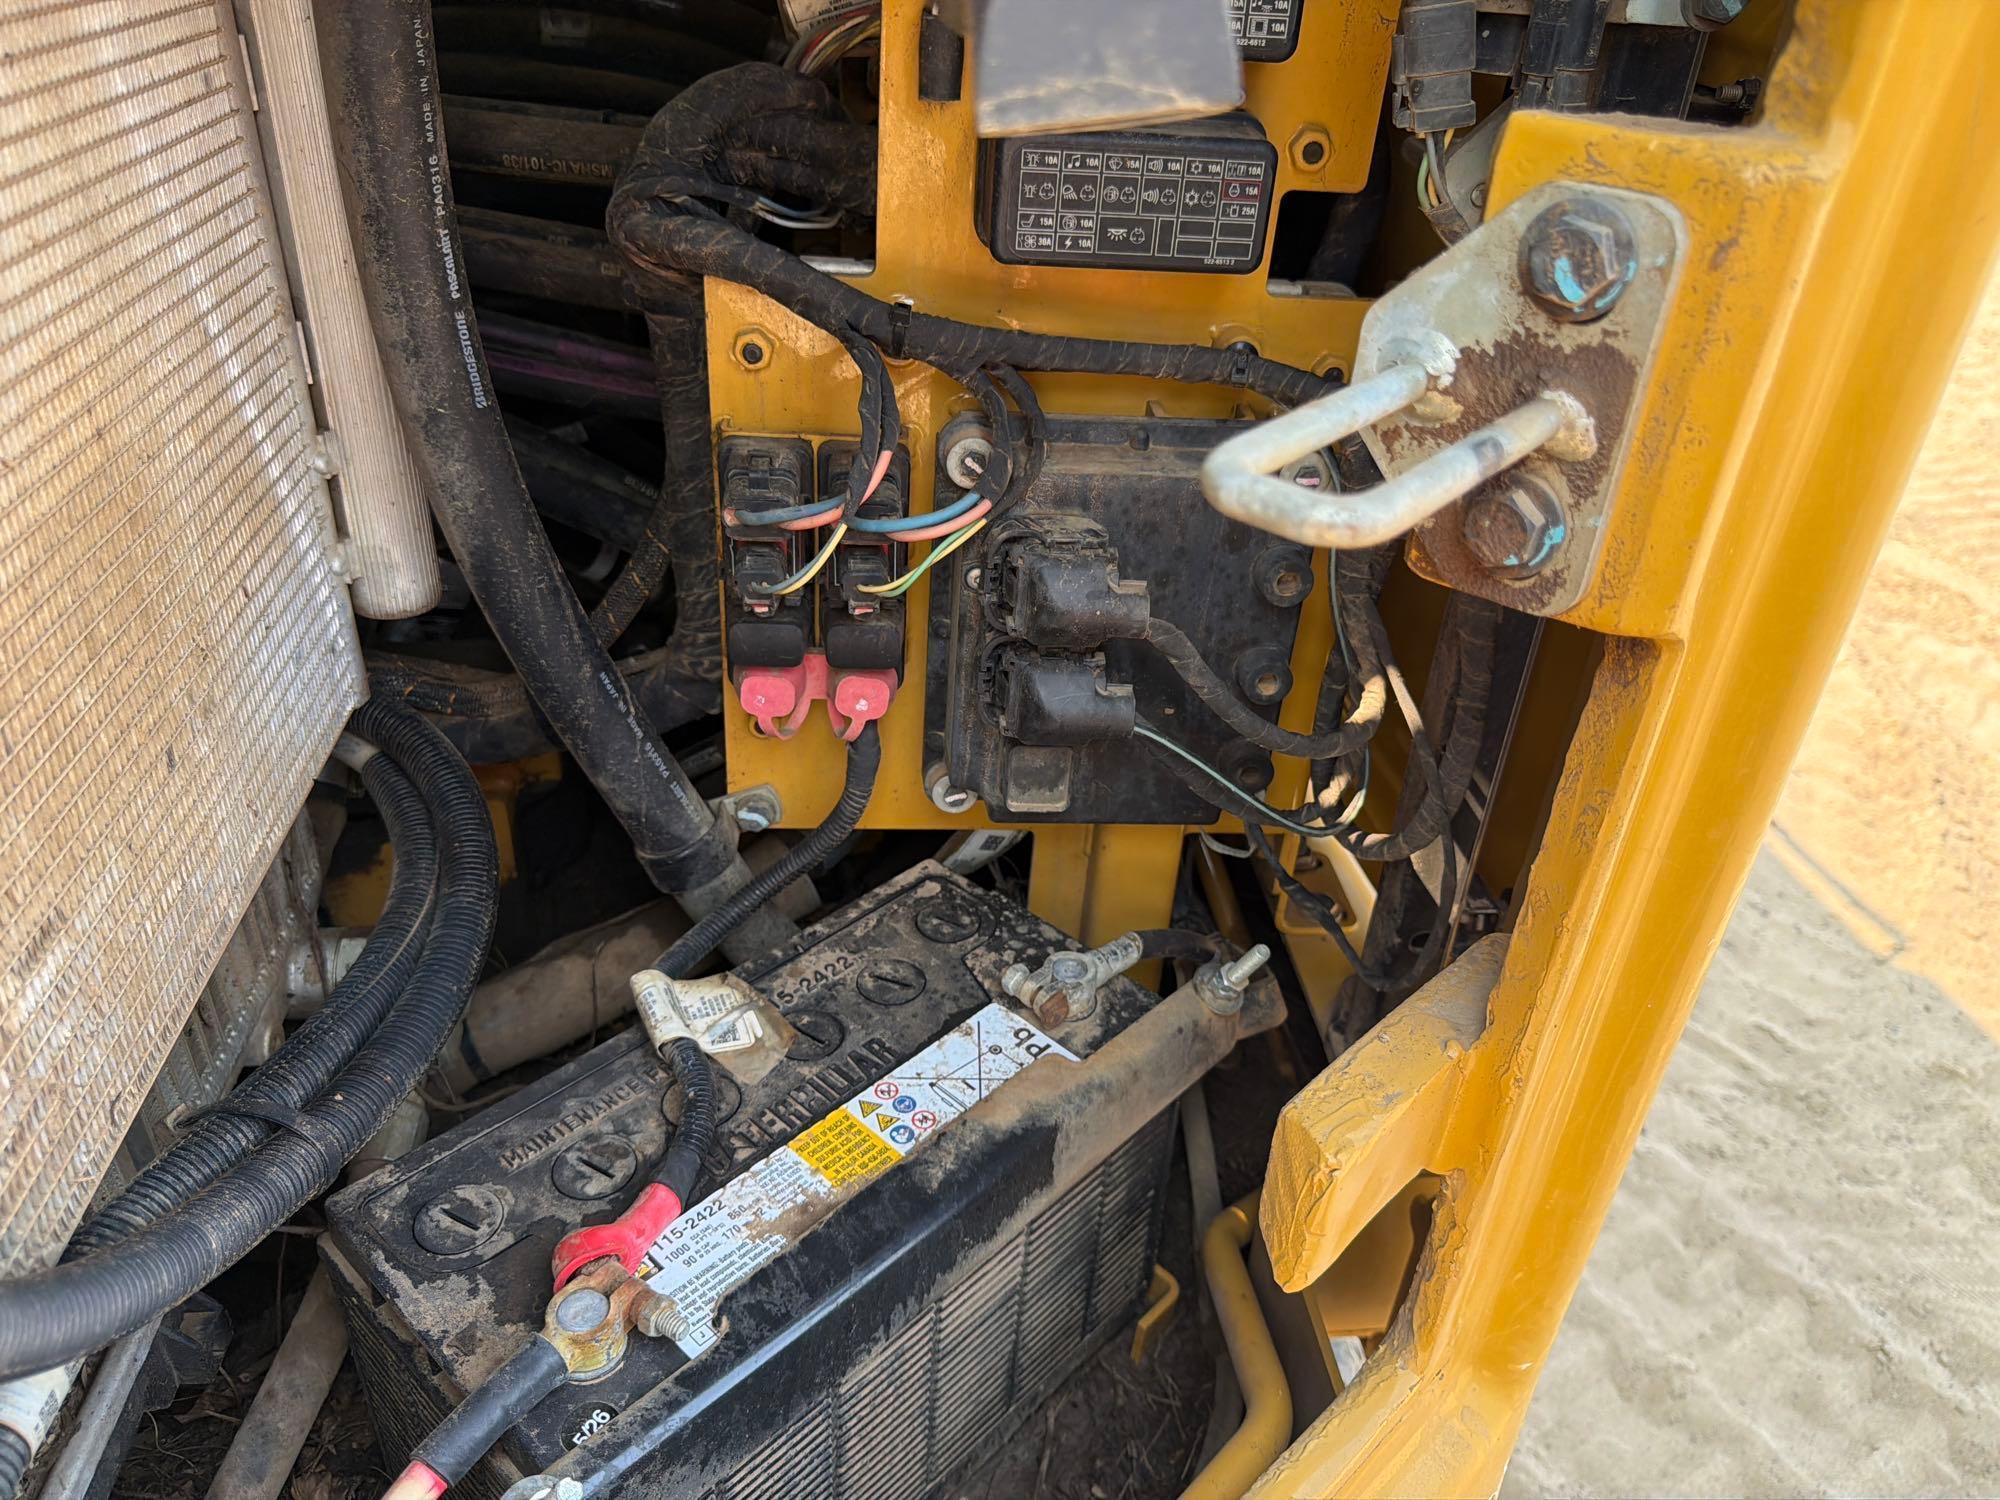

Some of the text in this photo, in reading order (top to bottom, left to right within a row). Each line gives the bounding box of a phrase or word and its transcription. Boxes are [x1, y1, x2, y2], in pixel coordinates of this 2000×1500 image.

[1274, 0, 1288, 9] 10A
[1271, 22, 1285, 32] 10A
[410, 17, 428, 66] JAPAN
[418, 76, 430, 92] IN
[420, 101, 436, 142] MADE
[1044, 156, 1058, 164] 10A
[1086, 158, 1099, 166] 10A
[1167, 162, 1180, 171] 10A
[1208, 164, 1220, 173] 10A
[1248, 167, 1261, 175] 10A
[427, 154, 447, 215] PA0316
[1246, 186, 1258, 195] 15A
[1040, 217, 1052, 226] 15A
[1242, 207, 1254, 215] 25A
[1080, 219, 1093, 228] 10A
[1038, 237, 1051, 246] 30A
[1079, 239, 1092, 248] 10A
[453, 308, 487, 409] BRIDGESTONE
[597, 670, 621, 699] JAPAN
[767, 946, 855, 1015] 15-2422
[1013, 1026, 1052, 1060] Pb
[695, 1027, 902, 1182] CATERPILLAR
[495, 1073, 646, 1175] MAINTENANCE
[808, 1133, 822, 1144] OUT
[818, 1128, 830, 1137] OF
[824, 1117, 845, 1133] REACH
[840, 1113, 851, 1122] OF
[830, 1120, 858, 1141] CONTAINS
[814, 1143, 842, 1164] SULFURIC
[821, 1133, 873, 1171] MEDICAL EMERGENCY
[854, 1141, 878, 1159] CANADA
[650, 1196, 727, 1254] 115-2422
[663, 1242, 692, 1264] 1000
[725, 1203, 748, 1221] 850
[681, 1254, 698, 1268] 90
[720, 1223, 742, 1241] 170
[572, 1408, 611, 1445] 5/26
